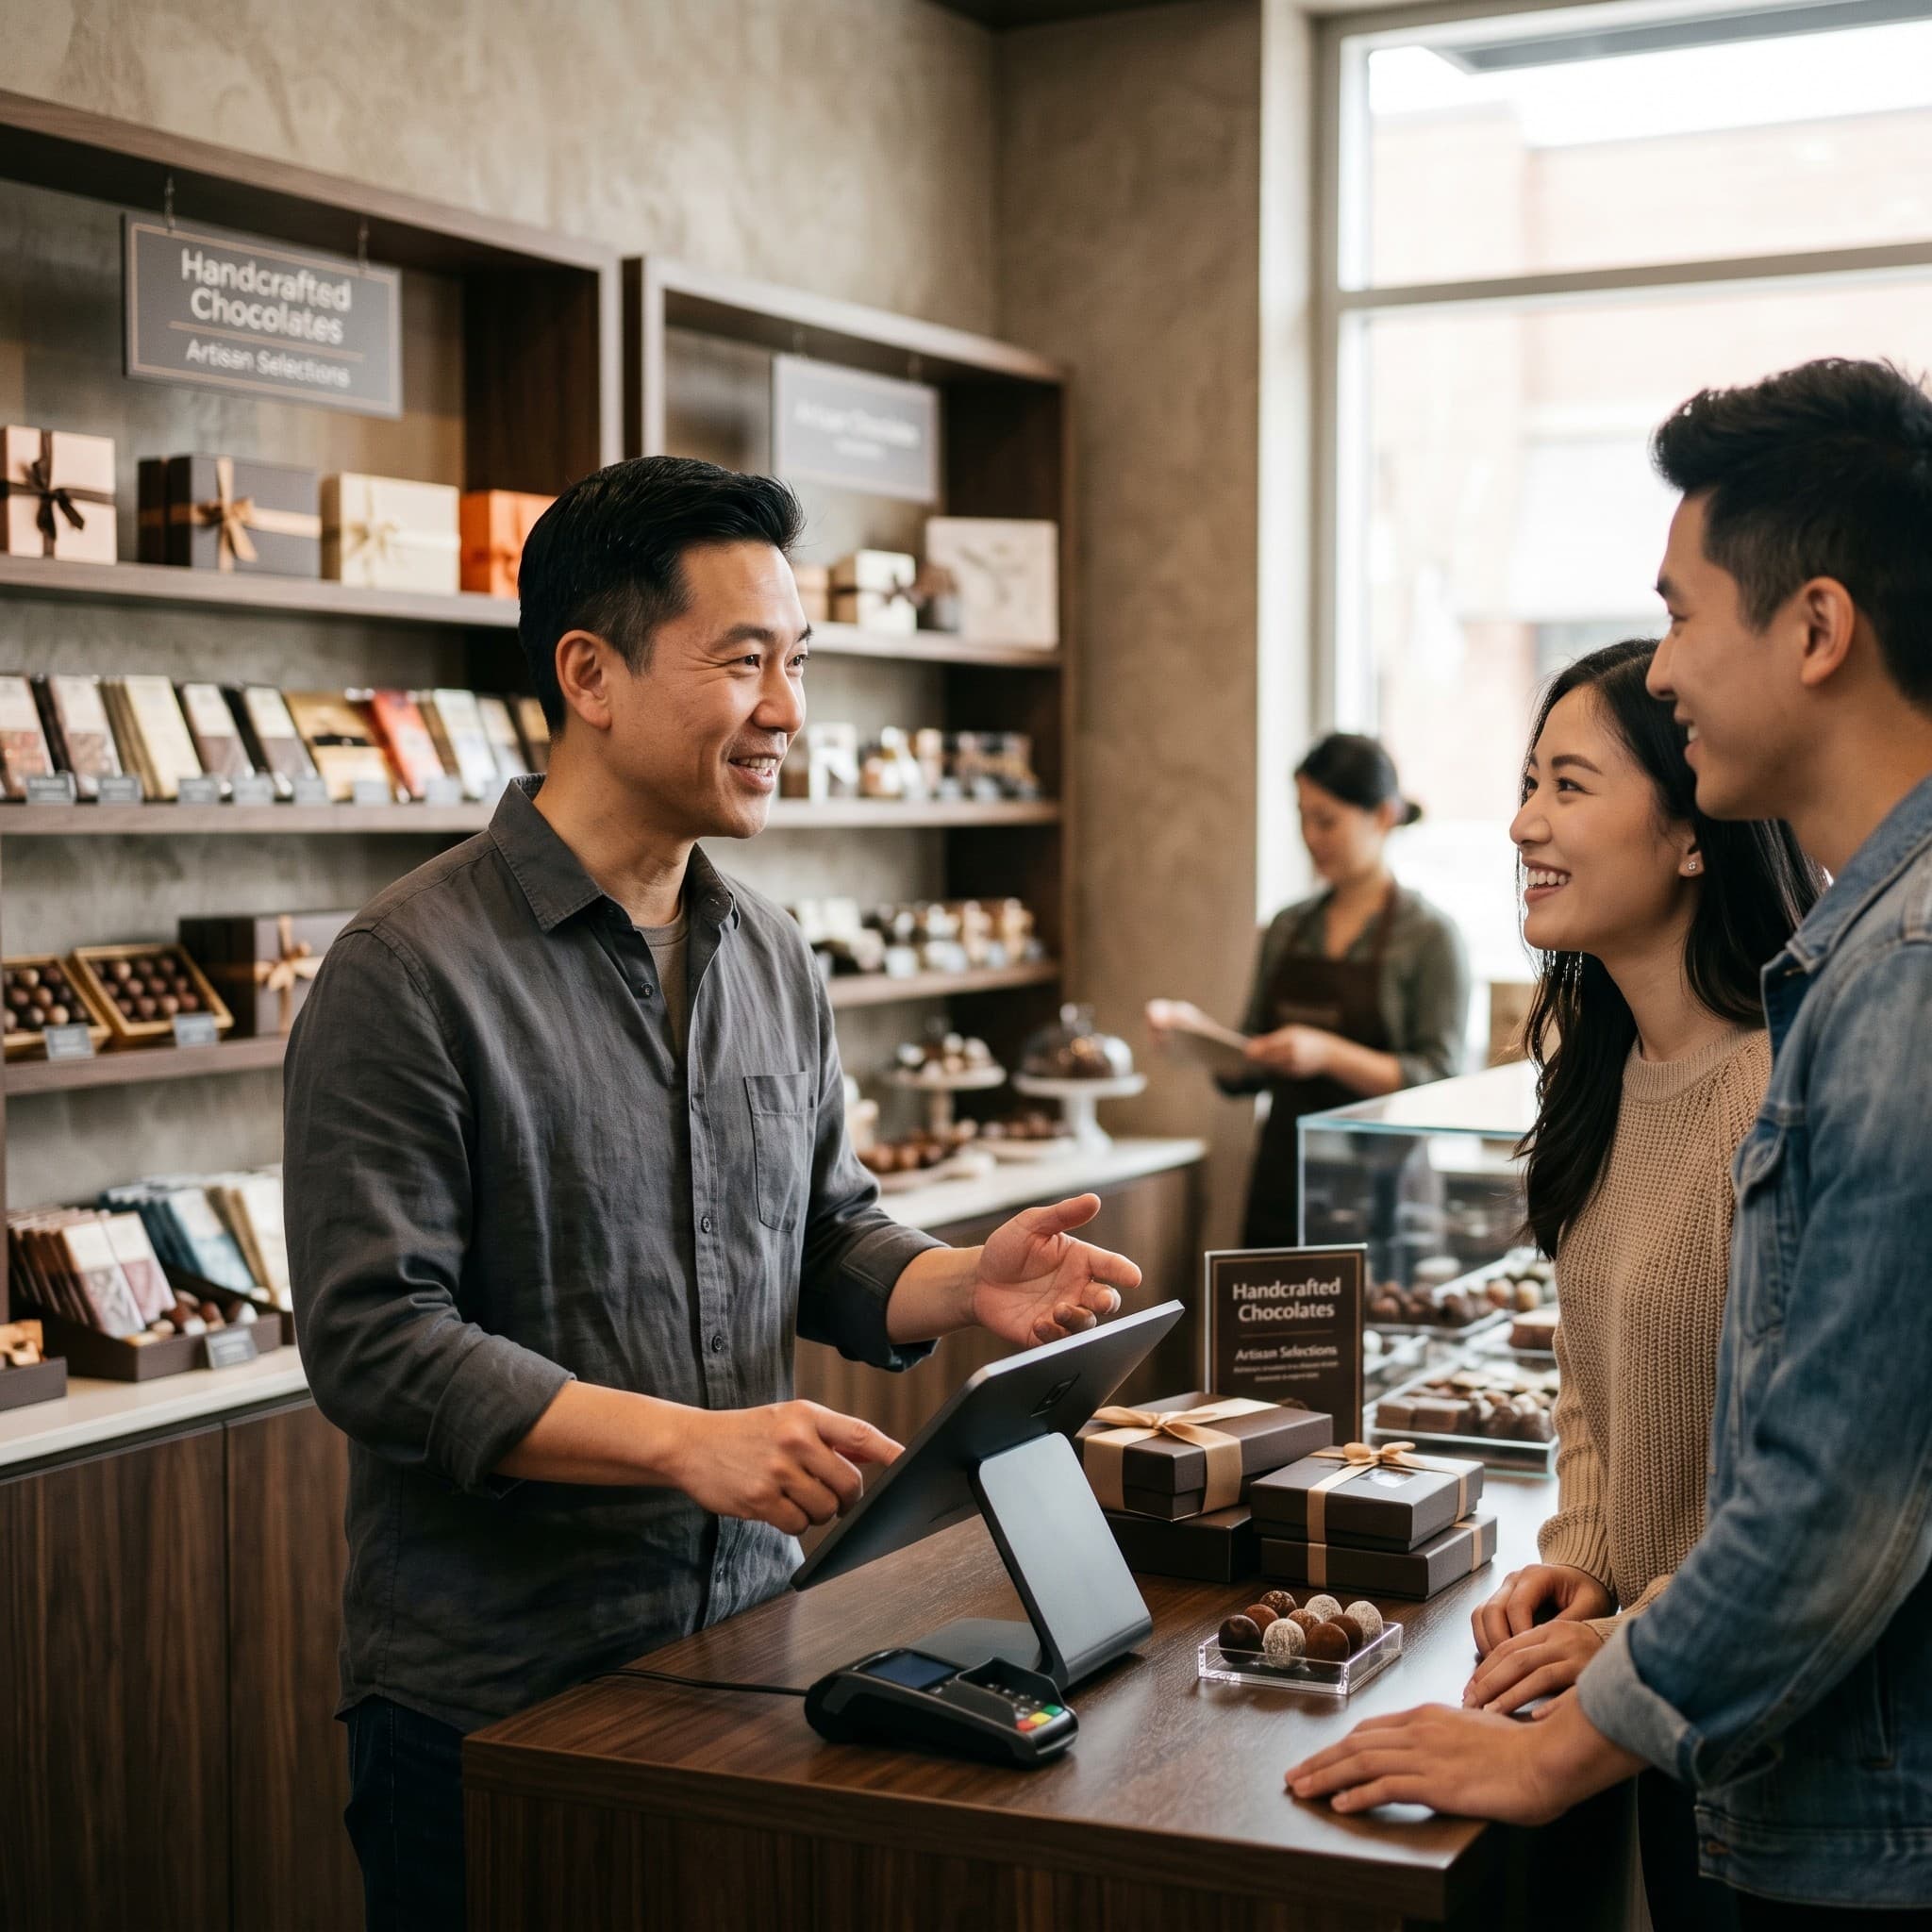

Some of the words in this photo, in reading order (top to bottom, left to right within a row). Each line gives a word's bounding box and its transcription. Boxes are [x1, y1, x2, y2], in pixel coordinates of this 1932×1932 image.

[182, 248, 352, 311] Handcrafted
[192, 287, 343, 344] Chocolates
[186, 339, 255, 371] Artisan
[256, 349, 351, 387] Selections
[1232, 1277, 1341, 1300] Handcrafted
[1239, 1301, 1335, 1322] Chocolates
[1235, 1349, 1277, 1361] Artisan
[1279, 1345, 1338, 1358] Selections
